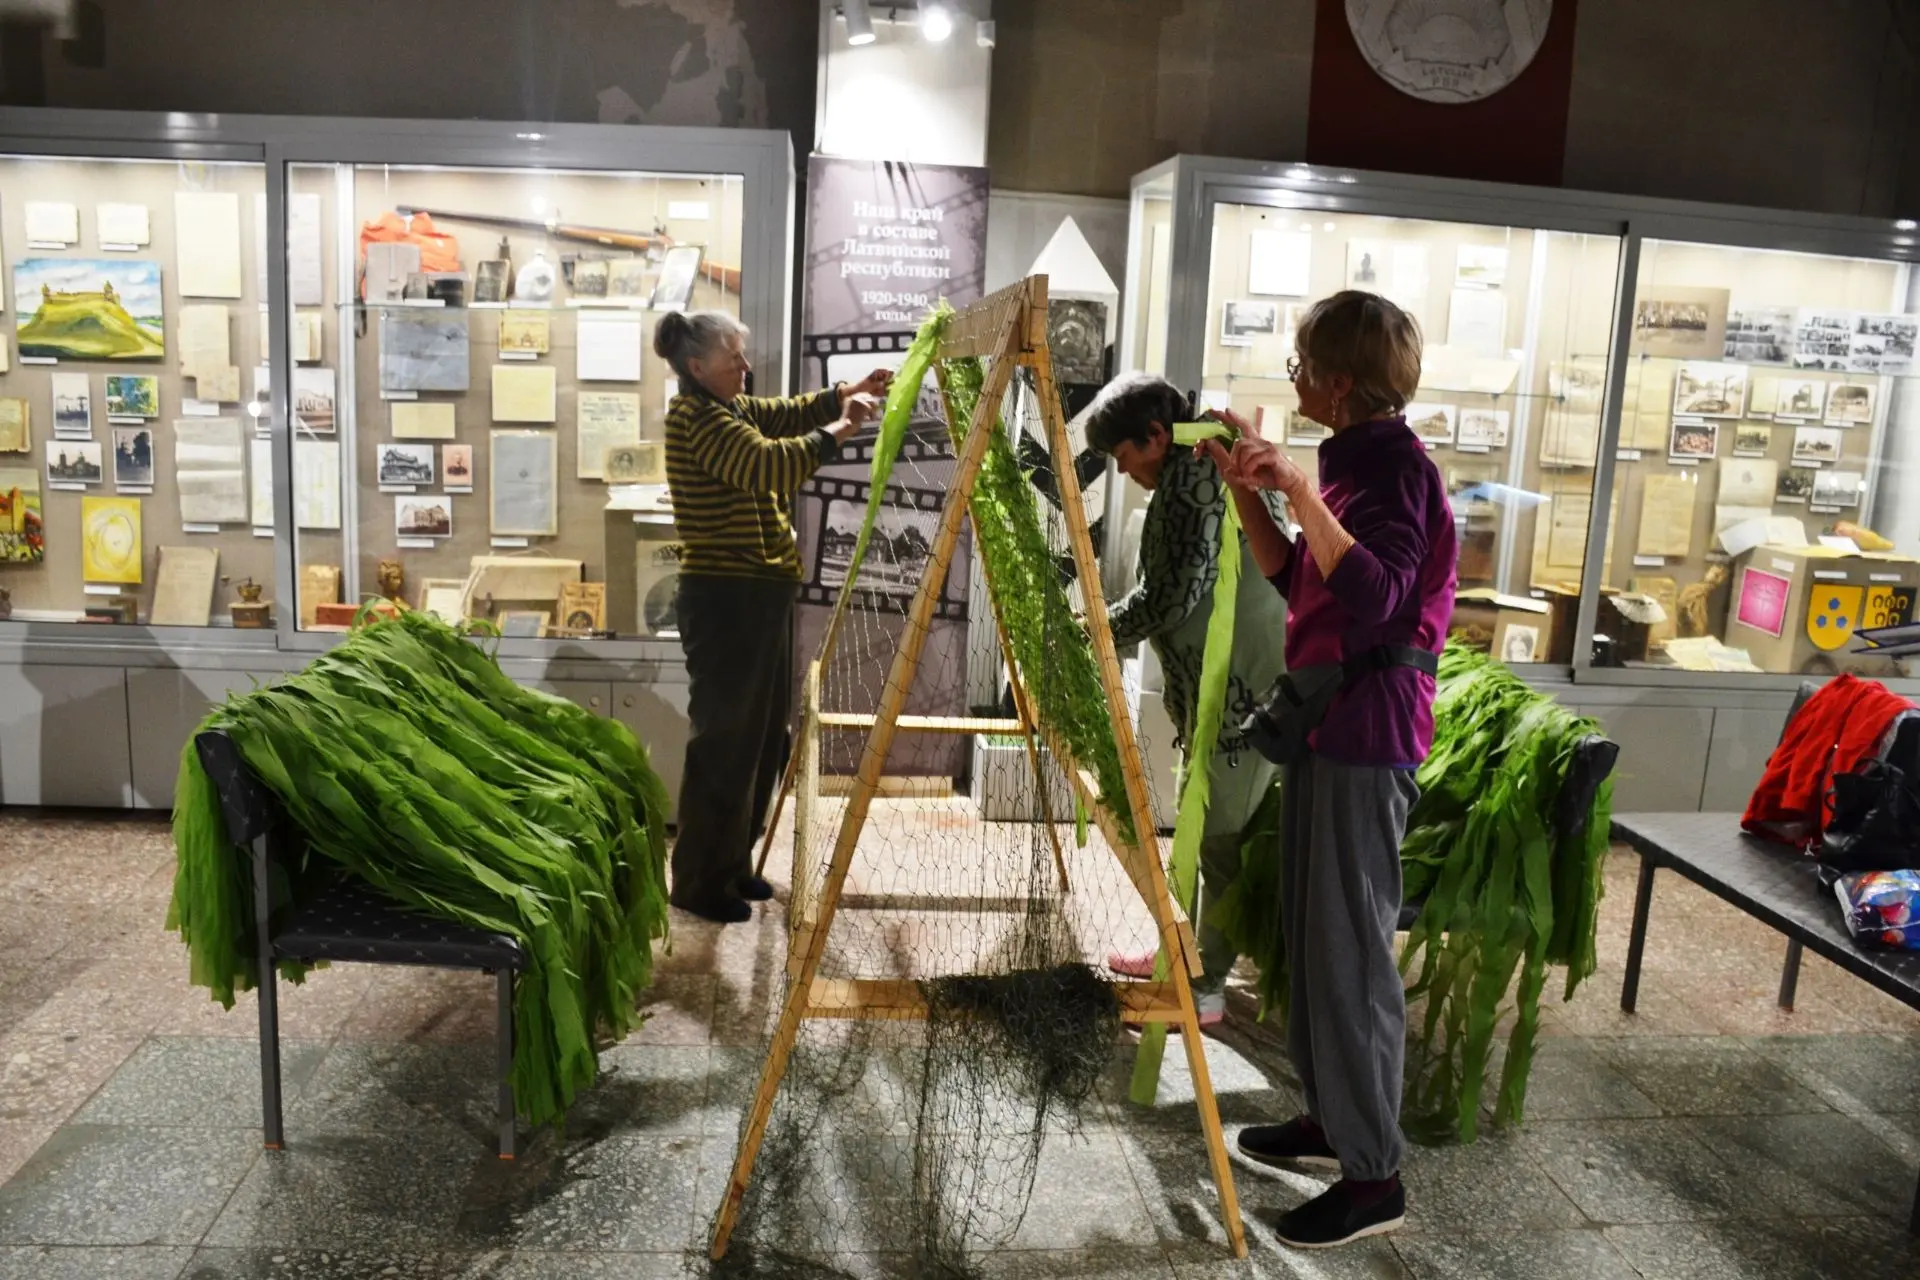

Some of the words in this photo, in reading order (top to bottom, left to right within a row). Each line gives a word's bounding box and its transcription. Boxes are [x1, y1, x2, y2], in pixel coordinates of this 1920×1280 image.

[853, 201, 895, 218] Наш
[901, 206, 944, 224] край
[857, 224, 868, 237] в
[872, 226, 938, 240] составе
[842, 239, 951, 259] Латвийской
[840, 260, 951, 280] республики
[862, 290, 928, 307] 1920-1940
[875, 310, 912, 322] годы
